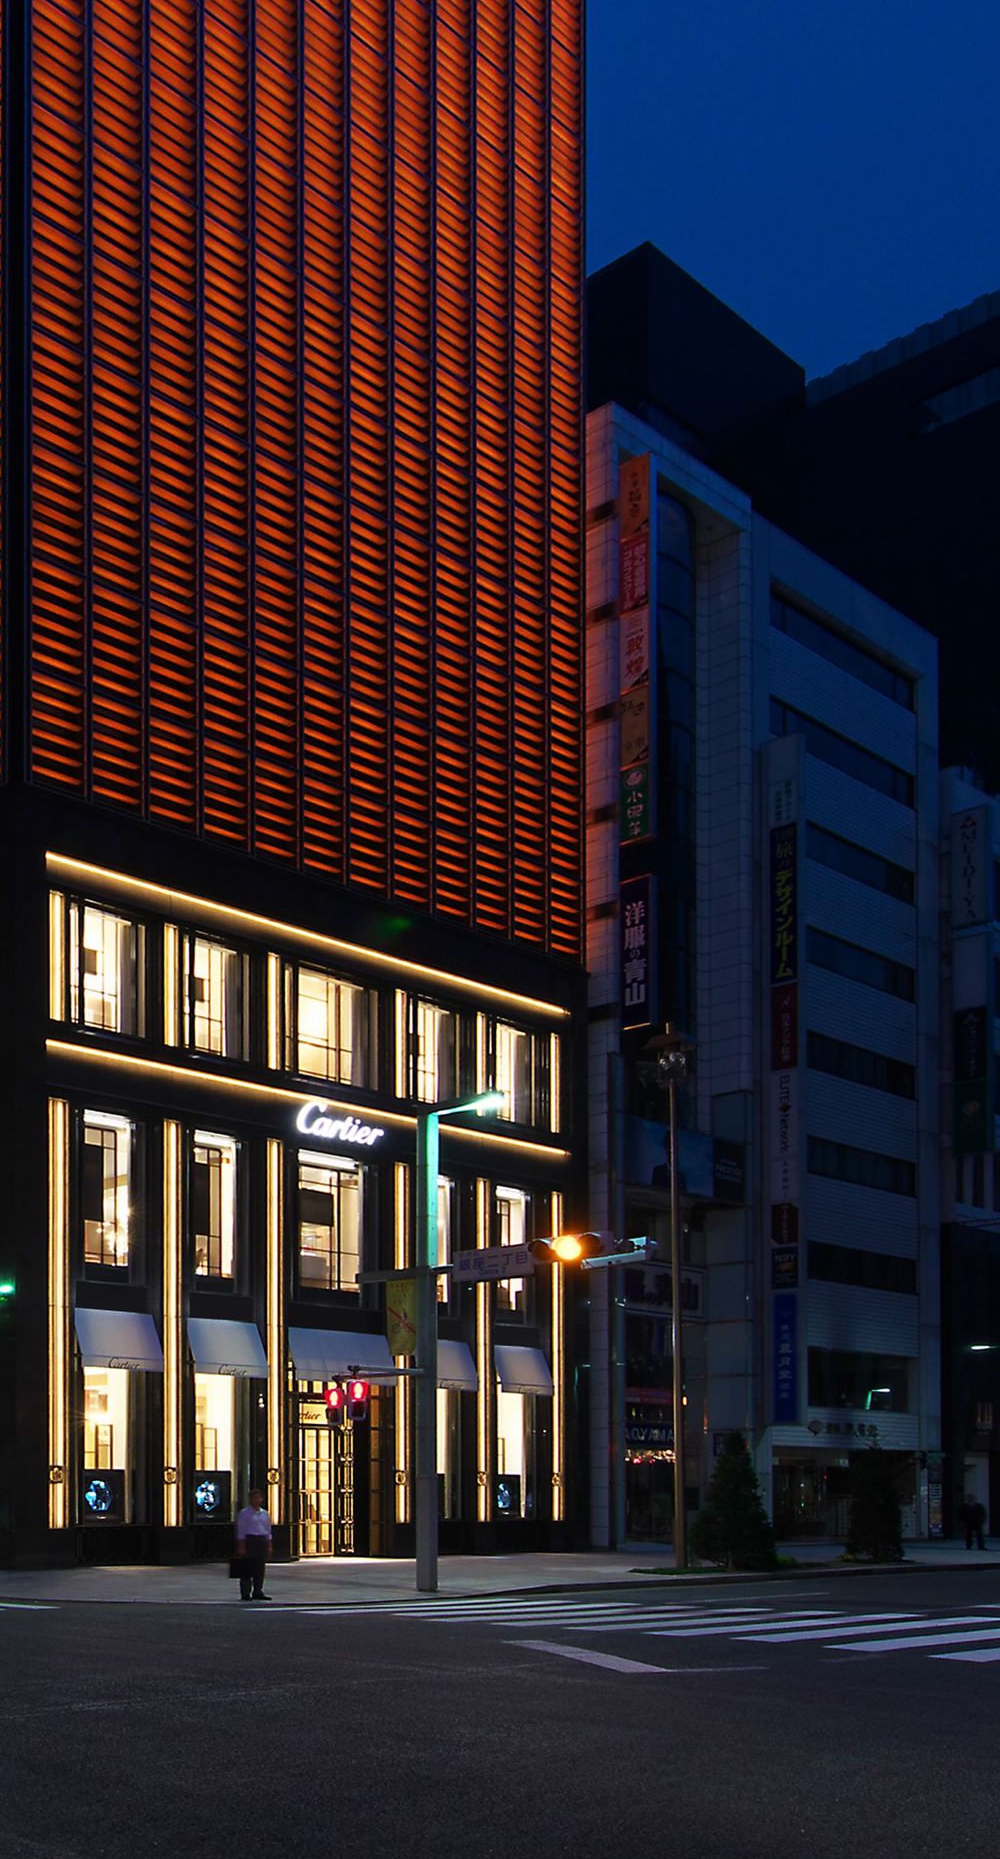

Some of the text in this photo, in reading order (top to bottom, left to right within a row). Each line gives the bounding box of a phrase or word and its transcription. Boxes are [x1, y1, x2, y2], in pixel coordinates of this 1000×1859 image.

[623, 899, 648, 1008] 洋服の青山
[296, 1100, 385, 1145] Cartier
[108, 1357, 140, 1370] Cartier
[300, 1409, 321, 1421] rtier
